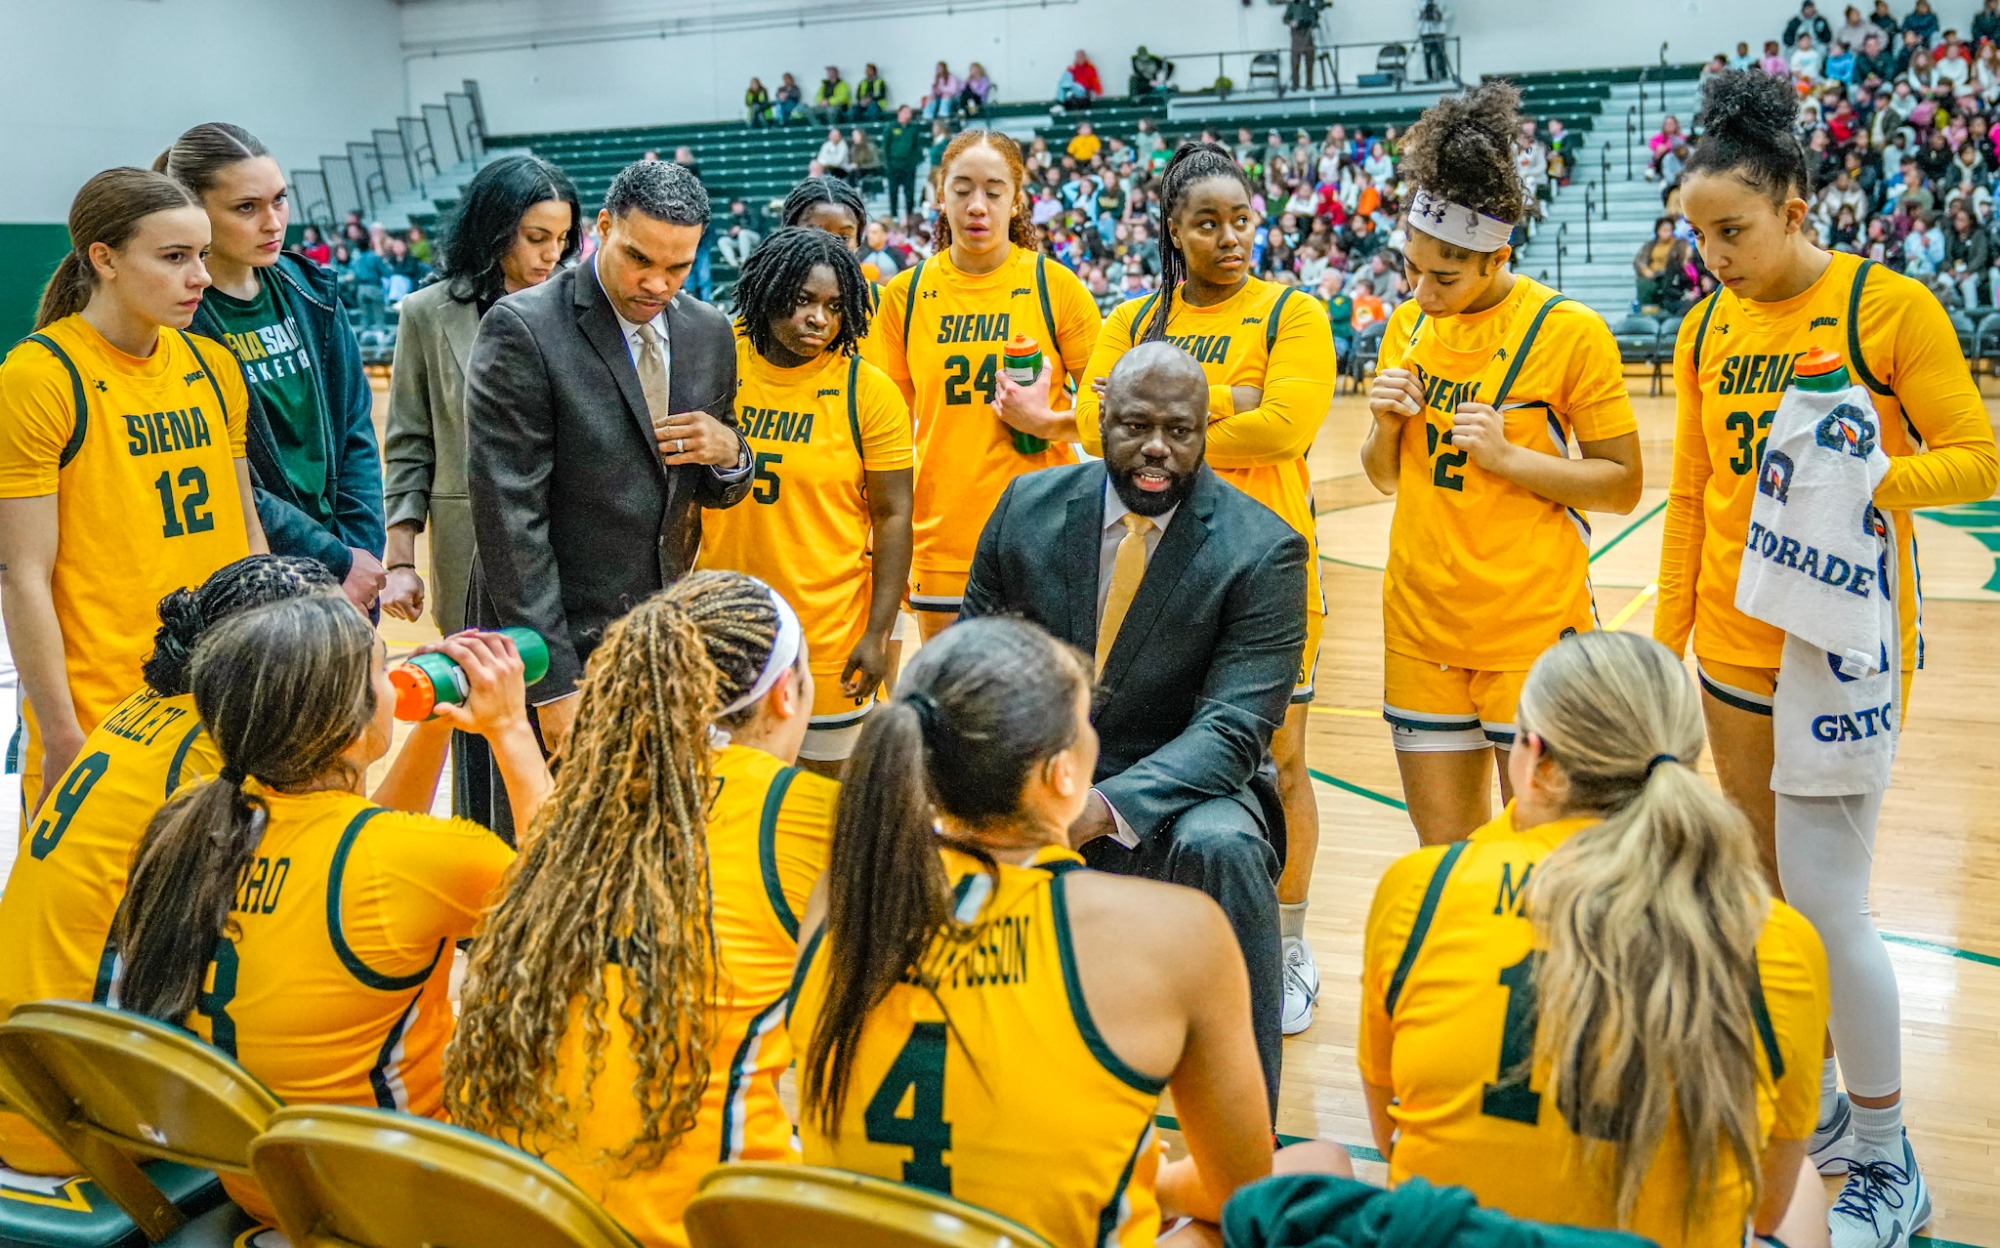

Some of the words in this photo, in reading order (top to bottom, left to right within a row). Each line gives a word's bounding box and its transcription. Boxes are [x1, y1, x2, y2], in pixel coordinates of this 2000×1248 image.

[937, 313, 1010, 344] SIENA
[944, 354, 998, 406] 24
[122, 406, 211, 456] SIENA
[737, 405, 815, 444] SIENA
[154, 466, 215, 539] 12
[30, 750, 110, 862] 9
[864, 1021, 953, 1197] 4
